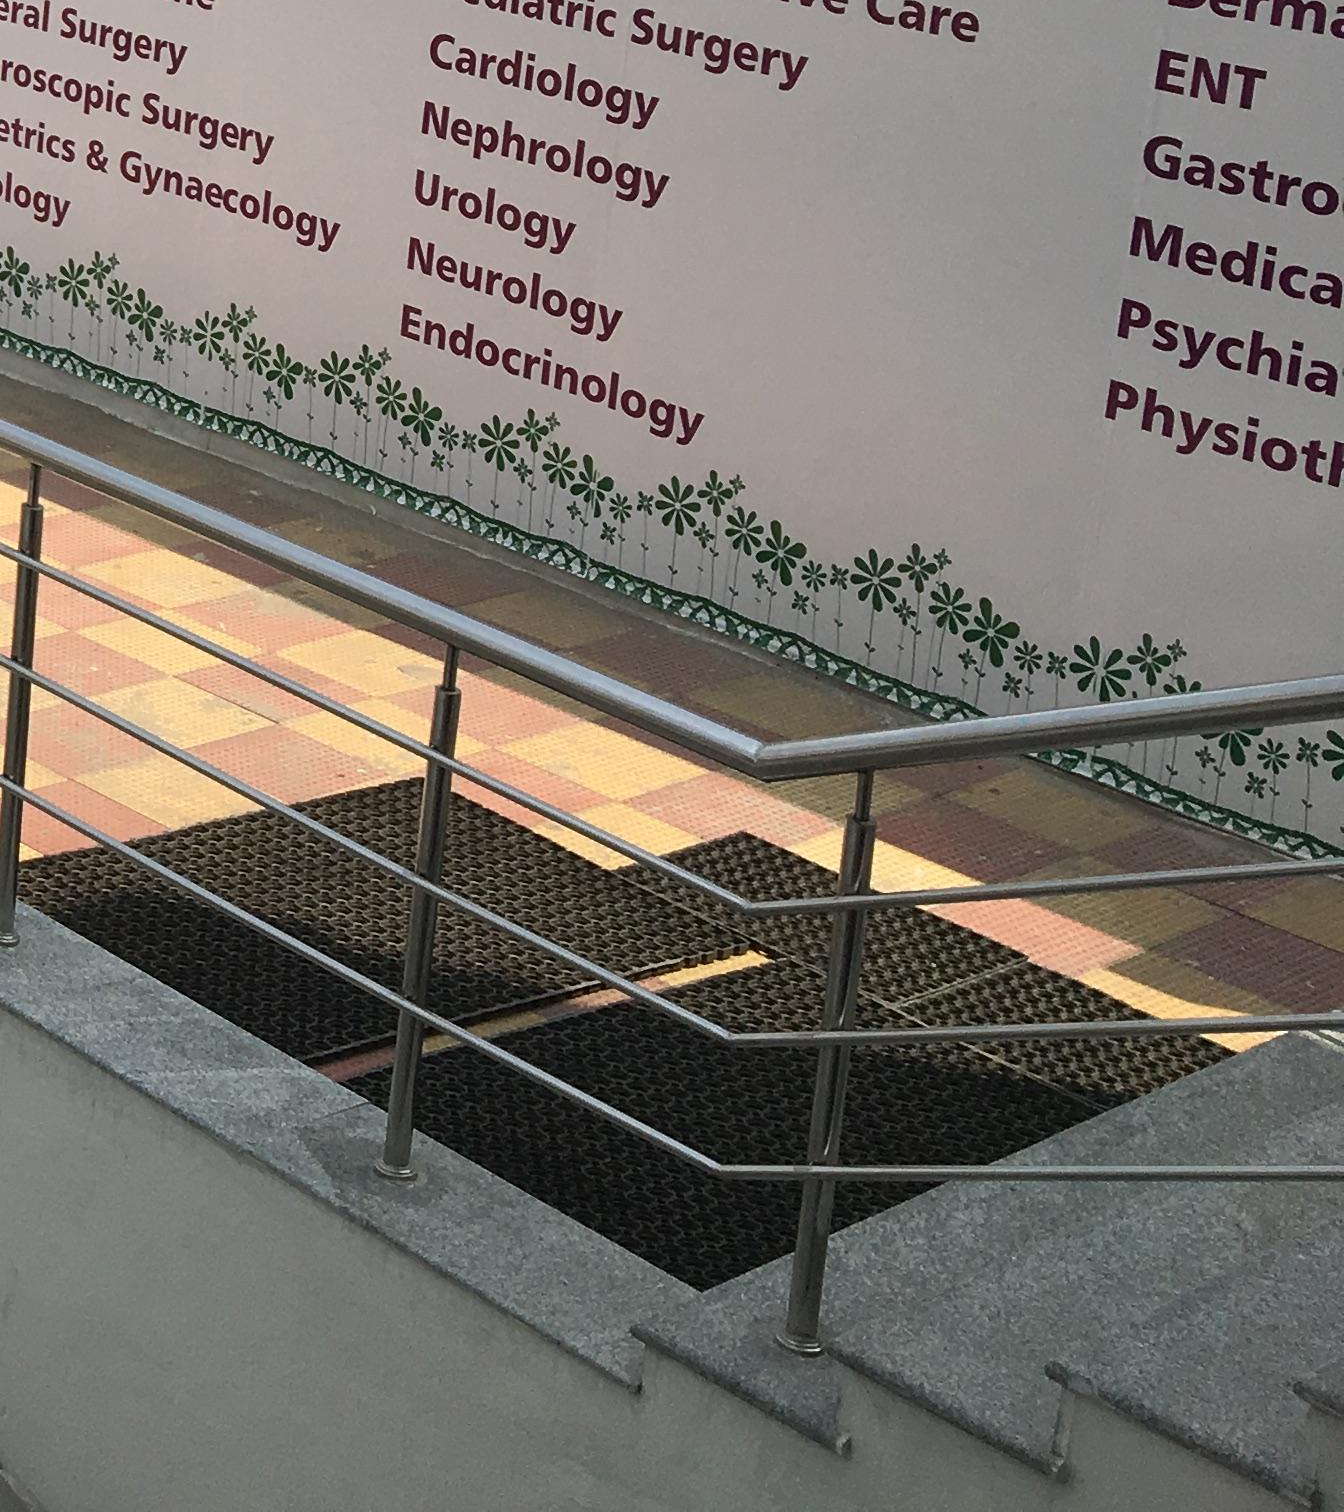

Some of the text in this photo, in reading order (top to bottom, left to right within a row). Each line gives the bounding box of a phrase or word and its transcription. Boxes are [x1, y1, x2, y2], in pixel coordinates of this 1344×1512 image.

[60, 9, 188, 76] Surgery
[430, 34, 661, 131] Cardiology
[631, 8, 810, 92] Surgery
[1155, 49, 1268, 110] ENT
[143, 94, 275, 166] Surgery
[421, 101, 671, 209] Nephrology
[1143, 135, 1344, 216] Gastro
[87, 140, 108, 173] &
[120, 151, 341, 252] Gynaecology
[415, 170, 576, 255] Urology
[407, 237, 624, 343] Neurology
[1129, 215, 1344, 309] Medica
[401, 304, 705, 446] Endocrinology
[1116, 297, 1344, 397] Psychia
